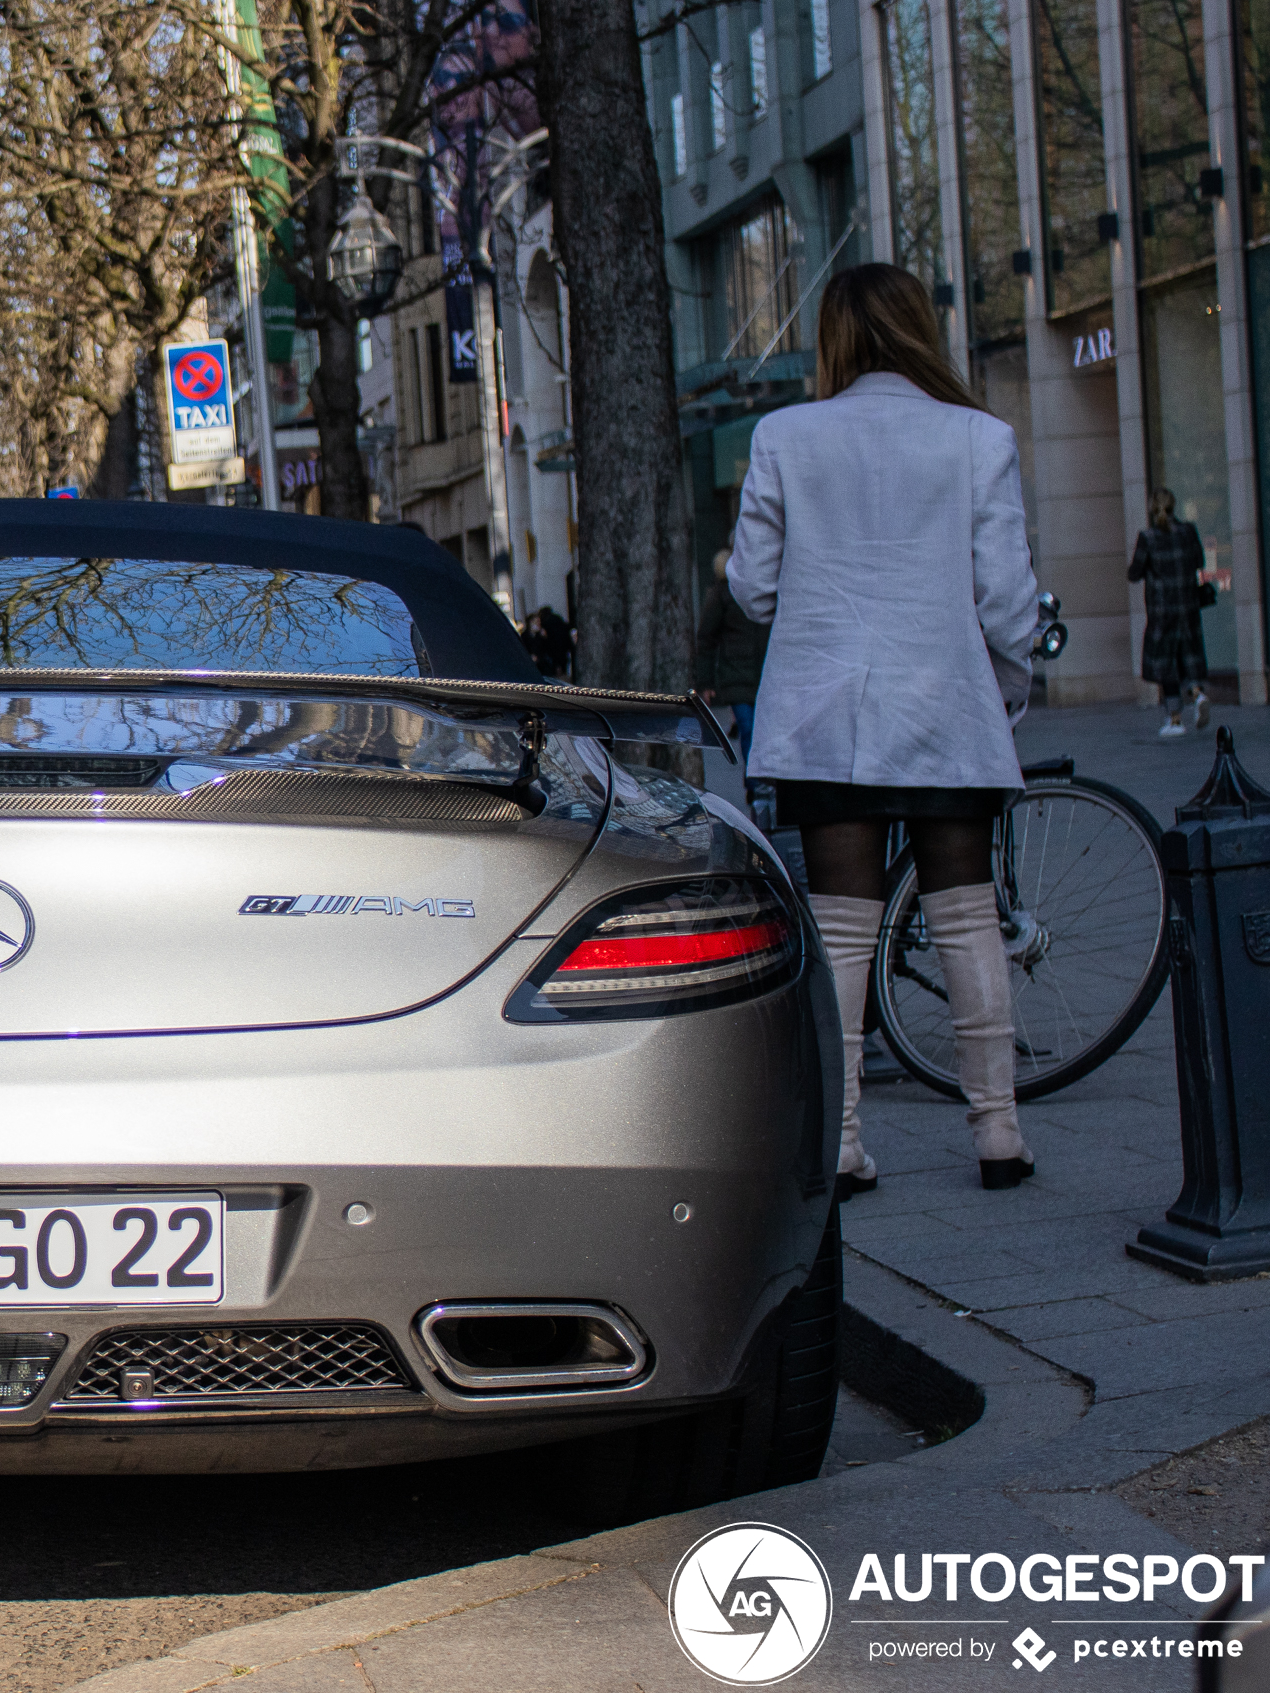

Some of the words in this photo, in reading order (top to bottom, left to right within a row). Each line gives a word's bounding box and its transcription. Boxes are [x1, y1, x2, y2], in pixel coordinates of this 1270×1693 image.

[175, 403, 227, 429] TAXI
[246, 897, 291, 914] GT
[350, 896, 476, 917] AMG
[111, 1206, 214, 1288] 22
